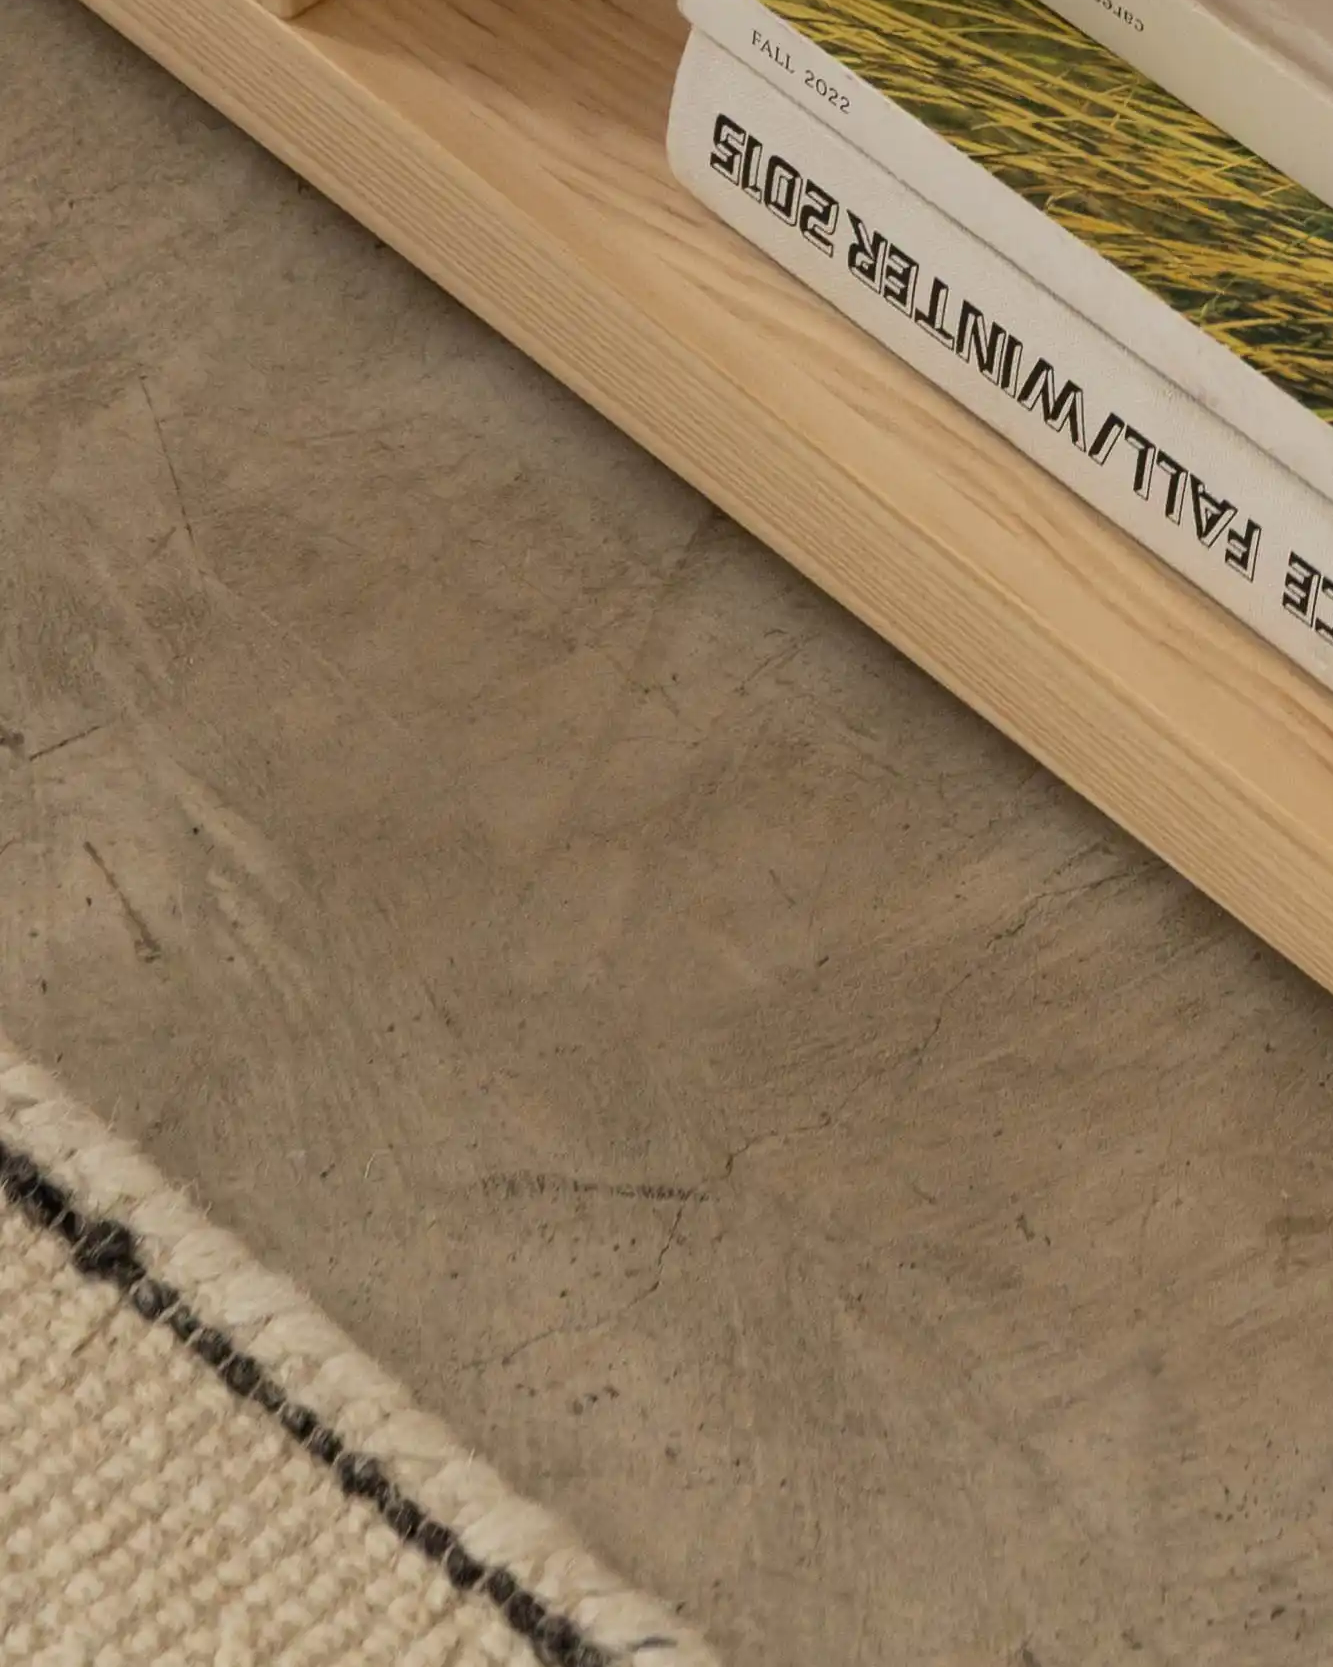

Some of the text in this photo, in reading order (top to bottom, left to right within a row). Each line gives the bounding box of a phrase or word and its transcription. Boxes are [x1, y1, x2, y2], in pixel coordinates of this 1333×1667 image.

[750, 28, 852, 116] FALL 2022
[708, 112, 841, 259] 2015
[844, 208, 1262, 583] FALL/WINTER
